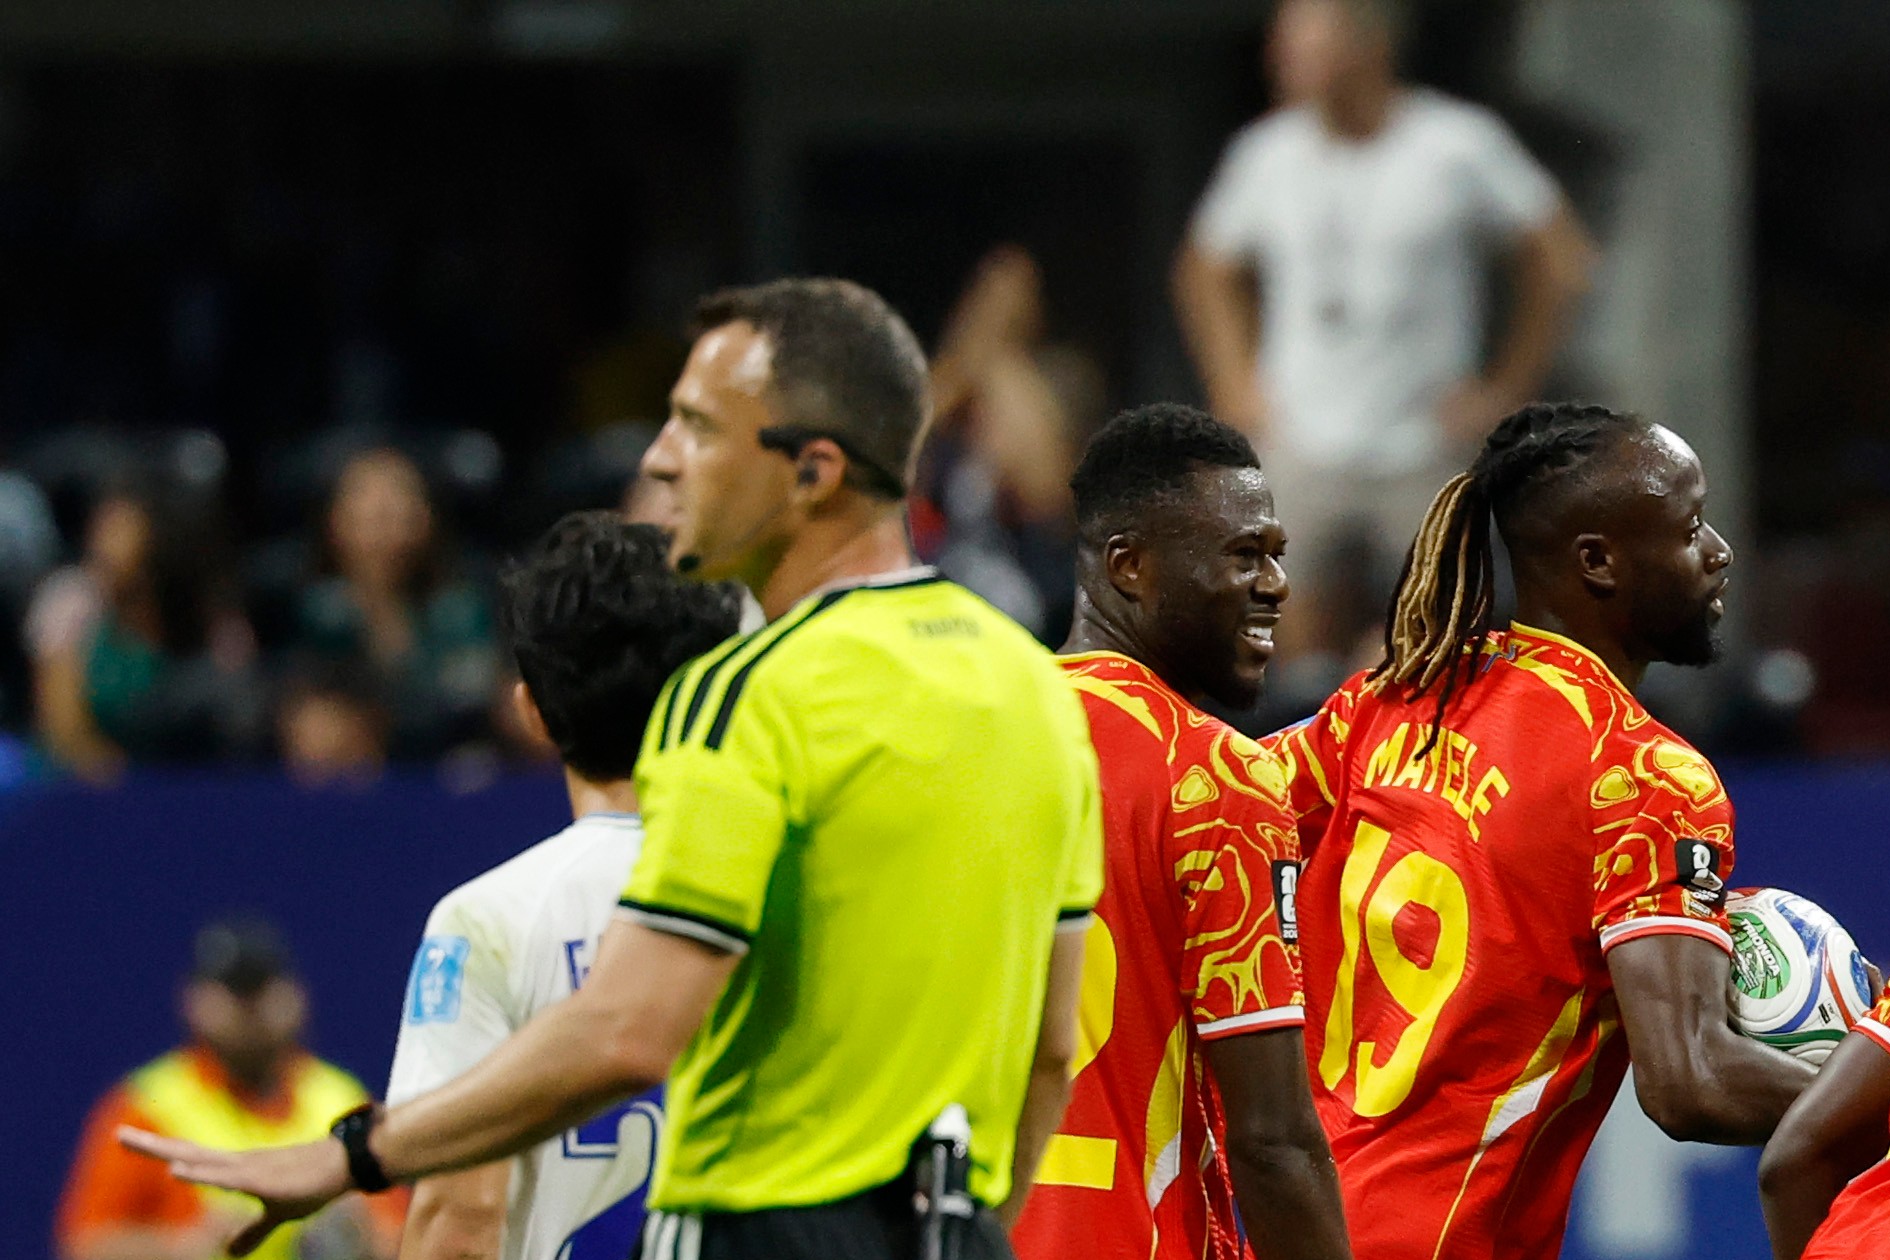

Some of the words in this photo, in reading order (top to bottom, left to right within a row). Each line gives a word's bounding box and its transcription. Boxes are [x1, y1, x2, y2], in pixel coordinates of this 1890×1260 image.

[1364, 722, 1511, 843] MAYELE
[1318, 818, 1468, 1118] 19
[1741, 918, 1781, 978] TRIONDA
